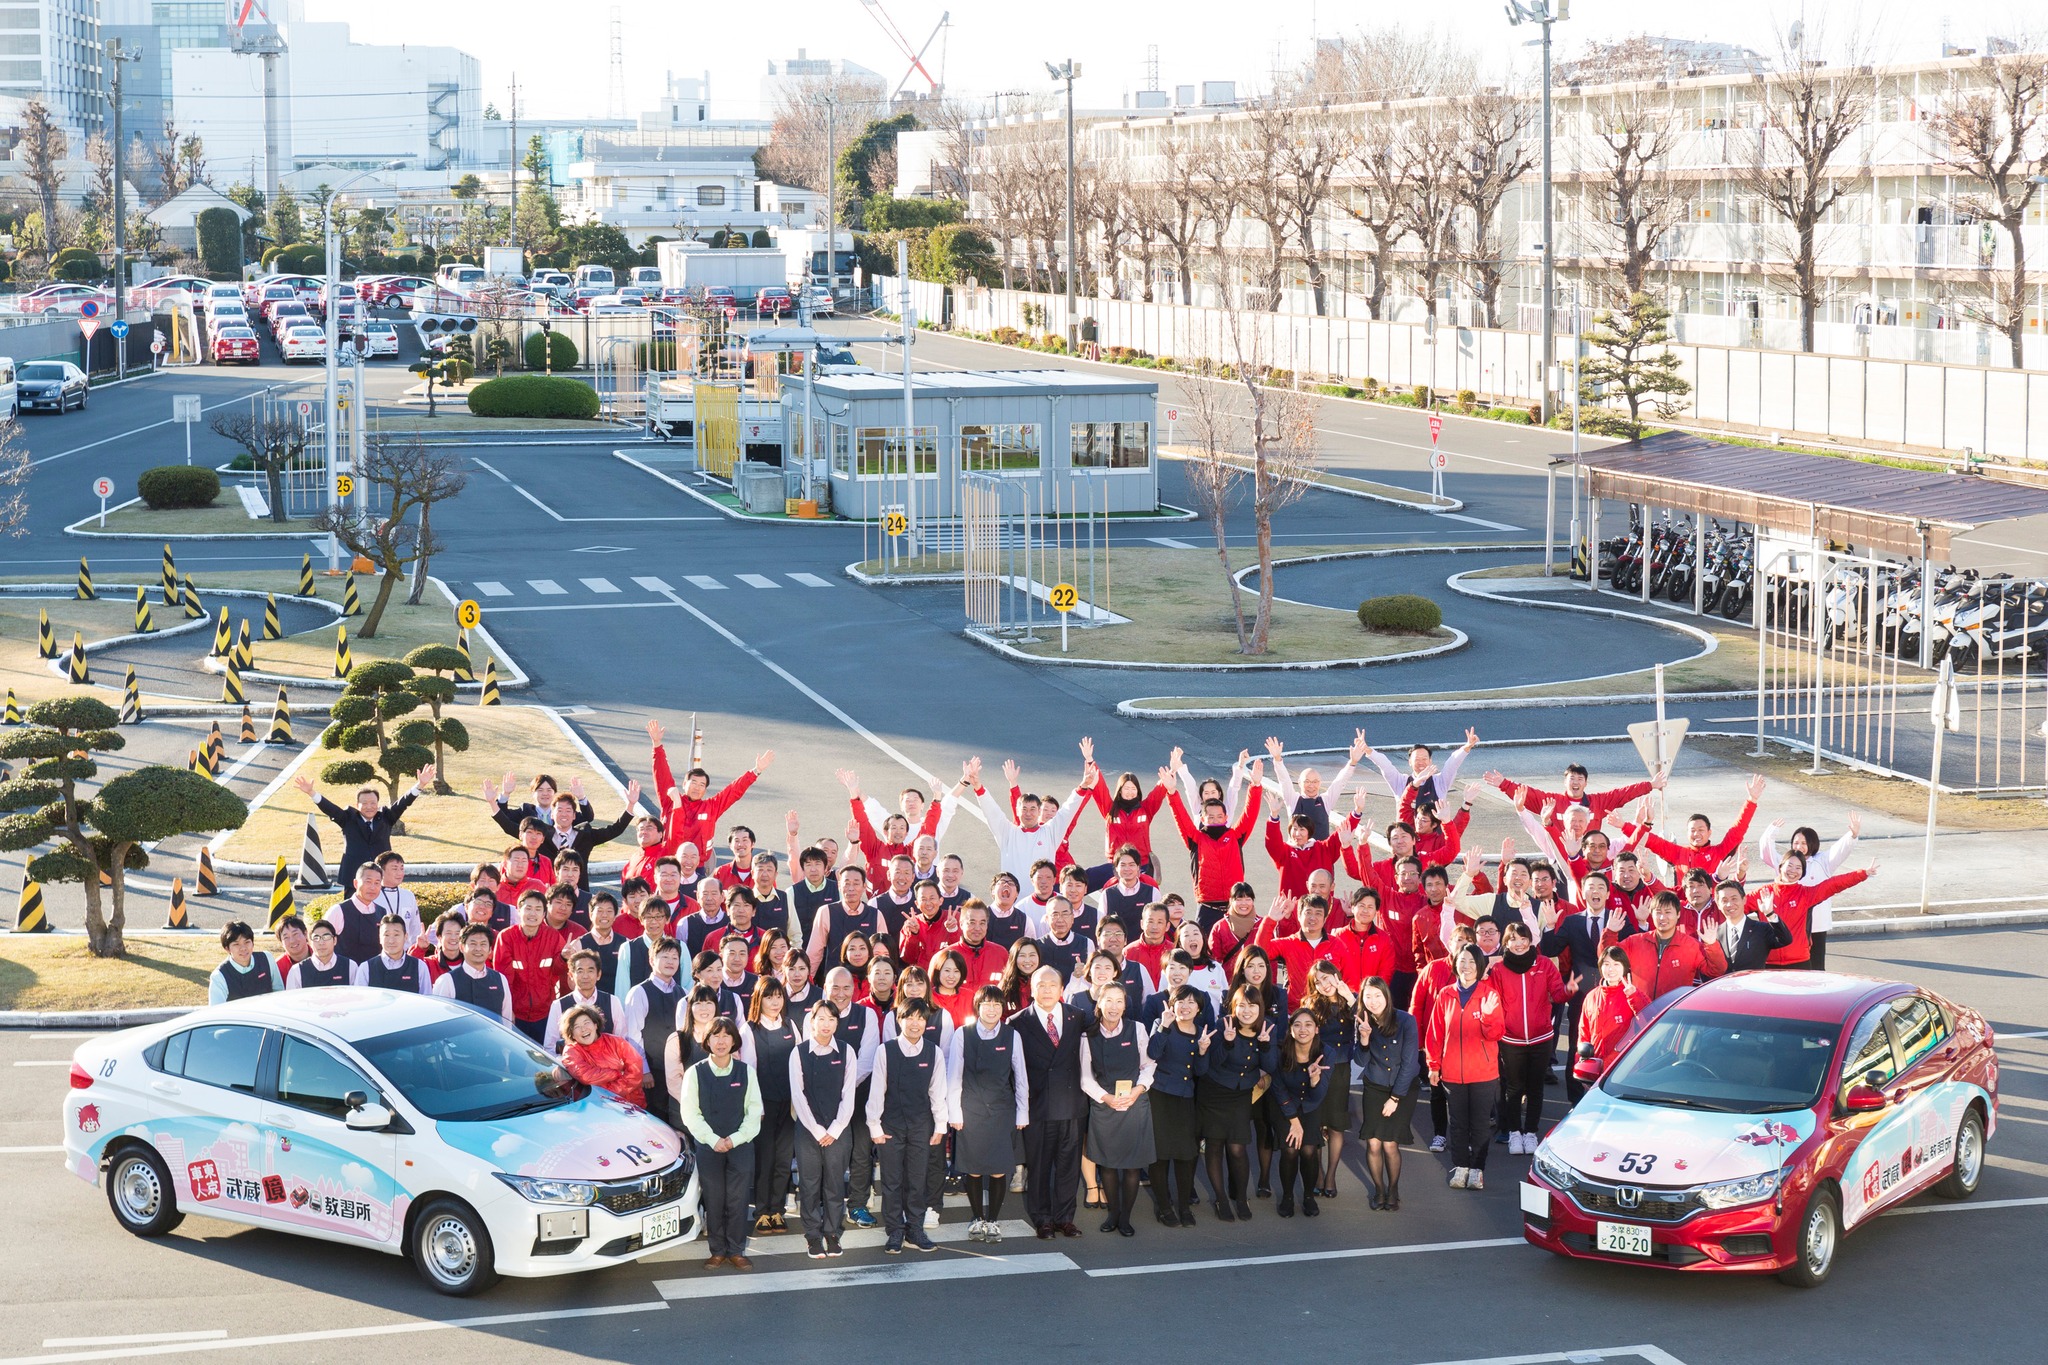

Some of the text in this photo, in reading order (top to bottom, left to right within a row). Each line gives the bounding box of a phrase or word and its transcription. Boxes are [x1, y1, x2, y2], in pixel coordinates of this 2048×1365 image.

[1167, 409, 1177, 420] 18
[99, 481, 109, 495] 5
[337, 479, 351, 493] 25
[887, 516, 904, 532] 24
[1053, 588, 1075, 607] 22
[465, 604, 475, 624] 3
[99, 1058, 117, 1078] 18
[616, 1144, 652, 1167] 18
[1618, 1152, 1658, 1175] 53
[325, 1196, 371, 1222] 教習所
[651, 1219, 678, 1240] 20-20
[1626, 1227, 1640, 1236] 830
[1609, 1235, 1649, 1253] 20-20
